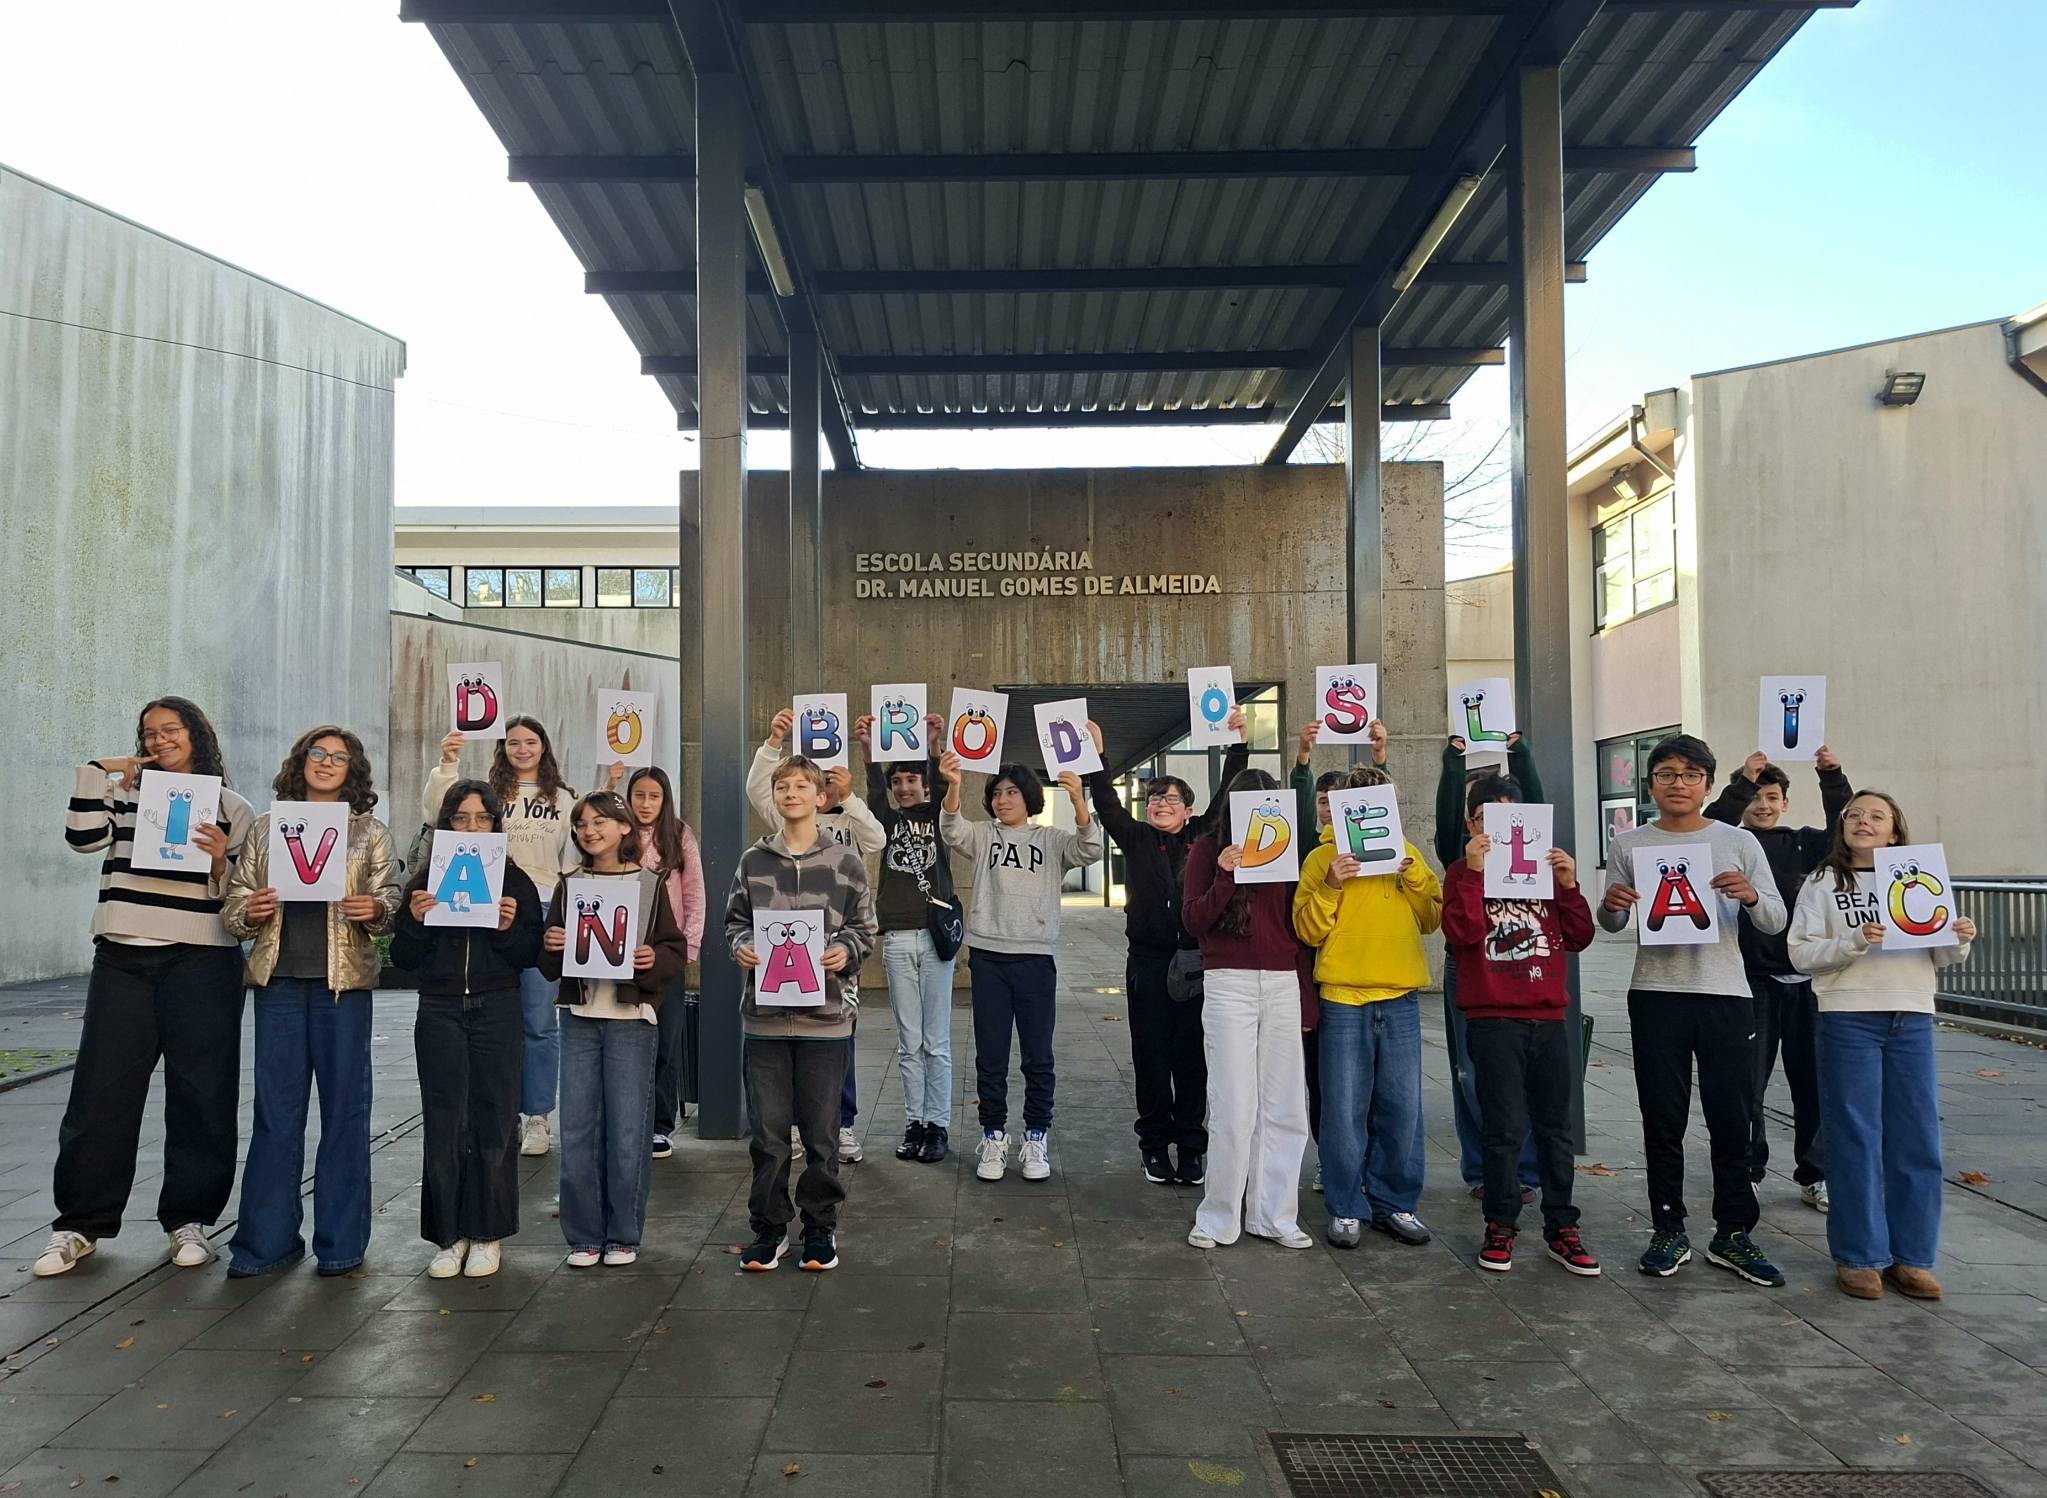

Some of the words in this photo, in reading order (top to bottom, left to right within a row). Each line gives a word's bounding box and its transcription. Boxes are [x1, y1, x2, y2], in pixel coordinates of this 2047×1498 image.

[856, 552, 944, 572] ESCOLA
[949, 545, 1093, 572] SECUNDÁRIA
[856, 579, 894, 598] DR.
[900, 578, 995, 598] MANUEL
[1000, 576, 1078, 597] GOMES
[1084, 575, 1113, 595] DE
[1119, 574, 1222, 595] ALMEIDA
[456, 681, 498, 732] D
[880, 702, 920, 751] R
[1200, 686, 1228, 723] O
[1324, 682, 1369, 734] S
[1465, 701, 1509, 742] L
[606, 709, 643, 755] O
[800, 706, 842, 759] B
[952, 709, 998, 760] O
[1049, 719, 1082, 764] D
[523, 797, 561, 821] York
[1344, 806, 1397, 862] E
[283, 826, 339, 885] V
[989, 842, 1043, 873] GAP
[1240, 807, 1291, 868] D
[1511, 825, 1538, 874] L
[435, 853, 493, 904] A
[1646, 870, 1711, 932] A
[1887, 869, 1949, 936] C
[575, 905, 629, 967] N
[760, 922, 820, 993] A
